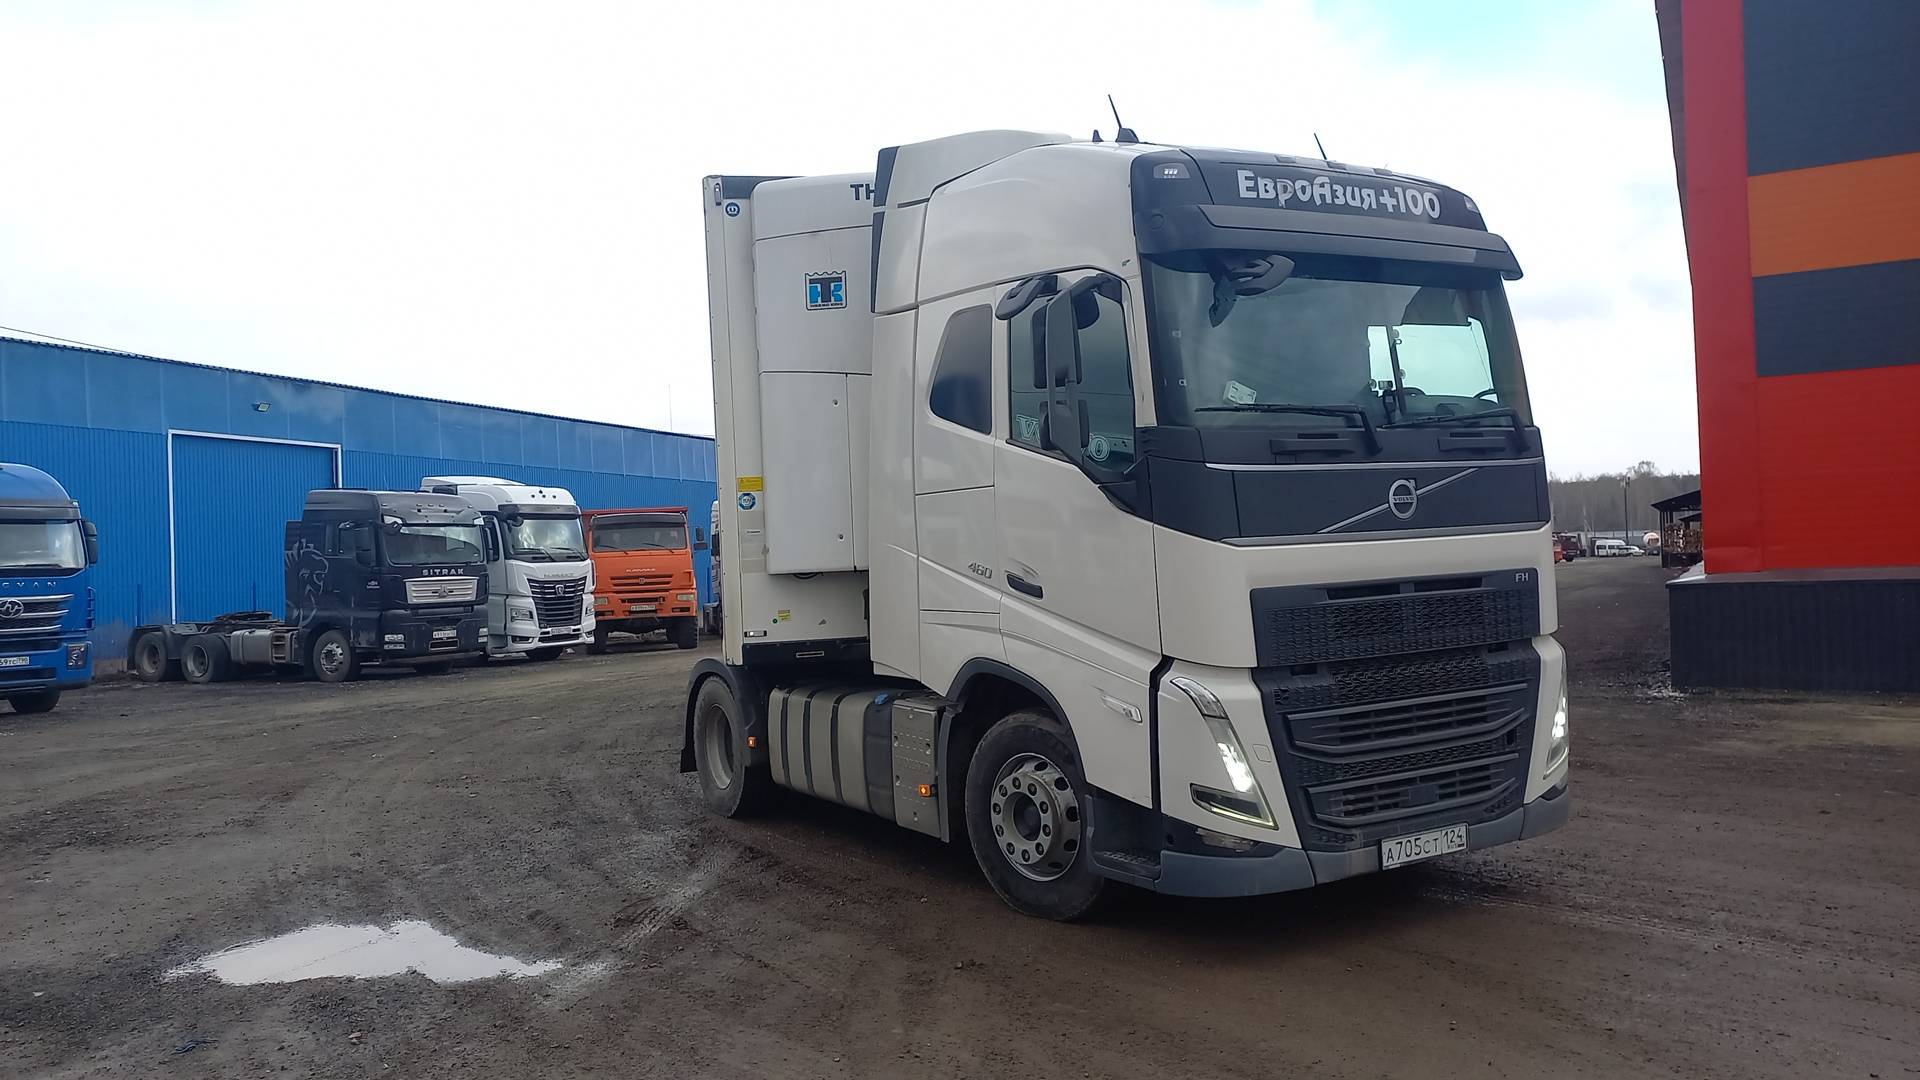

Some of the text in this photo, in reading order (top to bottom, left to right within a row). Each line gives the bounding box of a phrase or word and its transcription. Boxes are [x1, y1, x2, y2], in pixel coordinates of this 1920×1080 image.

[422, 568, 464, 576] SITRAK
[968, 562, 993, 579] 460
[1515, 572, 1529, 583] FH
